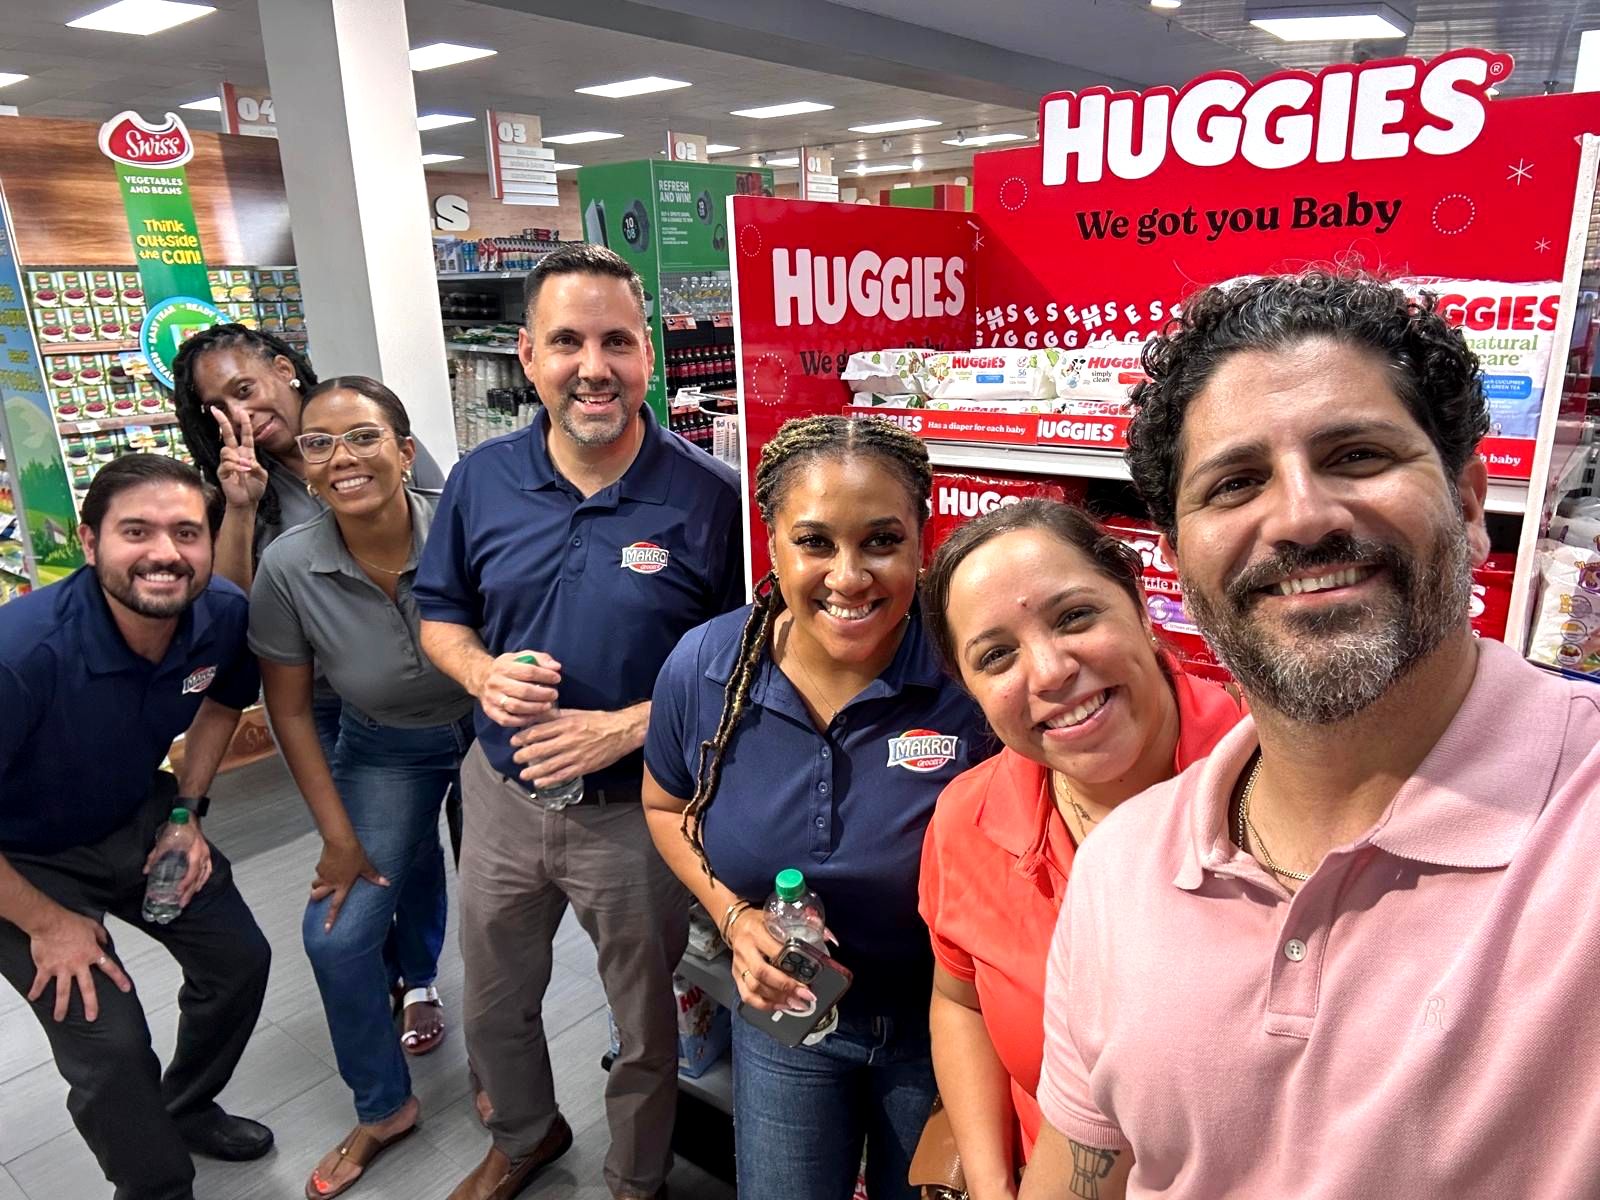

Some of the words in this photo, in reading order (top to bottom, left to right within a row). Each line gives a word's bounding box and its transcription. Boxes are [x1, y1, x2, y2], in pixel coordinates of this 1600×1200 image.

[1042, 56, 1488, 186] HUGGIES
[497, 122, 527, 143] 03
[125, 130, 180, 158] Swiss
[674, 141, 697, 160] 02
[807, 156, 822, 172] 01
[123, 176, 184, 186] VEGETABLES
[658, 180, 690, 192] REFRESH
[130, 186, 151, 194] AND
[151, 186, 182, 195] BEANS
[659, 191, 675, 203] AND
[675, 192, 692, 204] WIN!
[144, 219, 186, 232] Think
[1075, 209, 1129, 242] We
[1137, 203, 1199, 246] got
[1205, 203, 1279, 242] you
[1291, 191, 1403, 237] Baby
[139, 250, 160, 259] the
[772, 247, 965, 328] HUGGIES
[185, 303, 217, 318] READY
[800, 352, 833, 376] We
[952, 355, 1006, 369] HUGGIES
[928, 421, 942, 429] Has
[948, 422, 974, 431] diaper
[974, 423, 986, 431] for
[986, 424, 1005, 433] each
[1005, 425, 1026, 435] baby
[1489, 453, 1521, 466] baby
[626, 549, 667, 563] MAKRO
[895, 739, 952, 760] MAKRO
